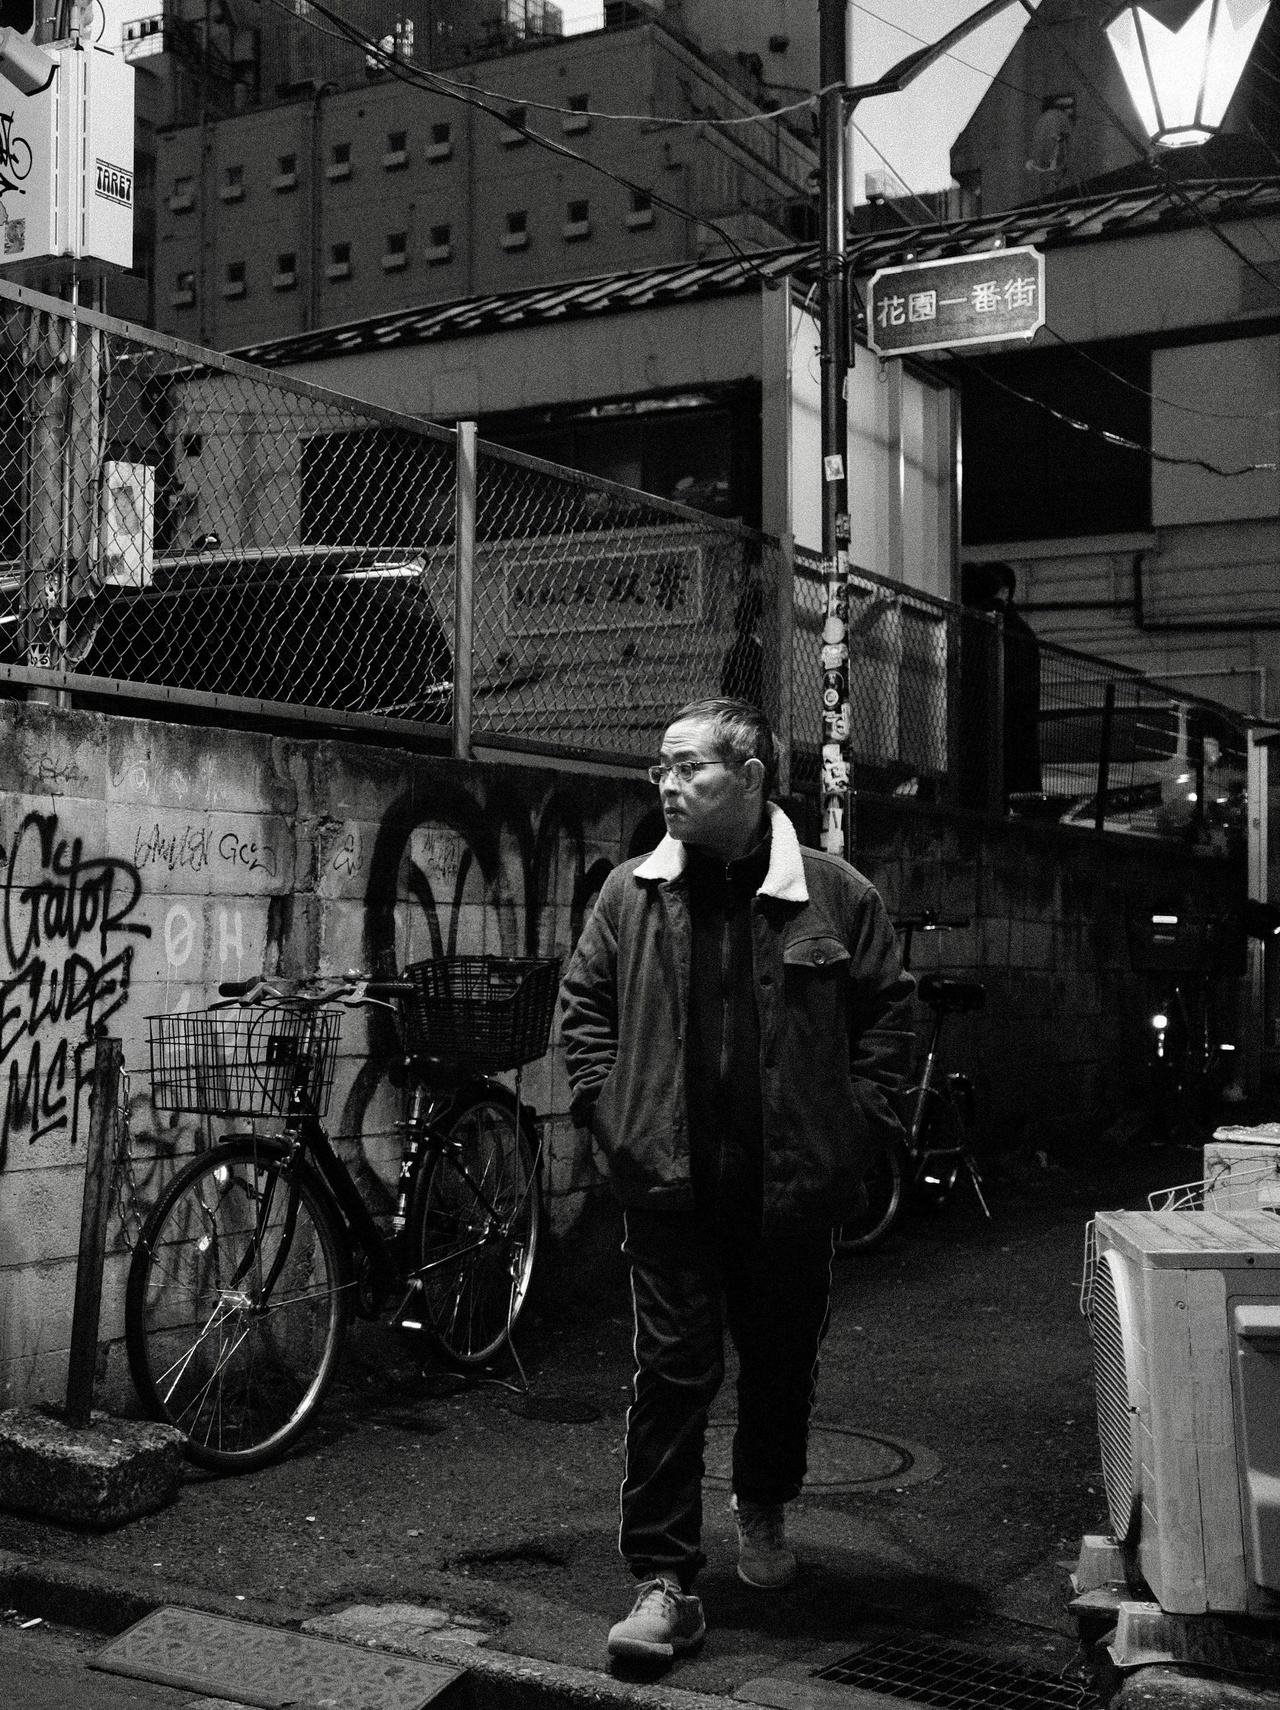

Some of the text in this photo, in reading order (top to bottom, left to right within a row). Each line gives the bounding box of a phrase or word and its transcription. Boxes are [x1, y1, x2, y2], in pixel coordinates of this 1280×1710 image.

[877, 277, 1037, 328] 花園一番街
